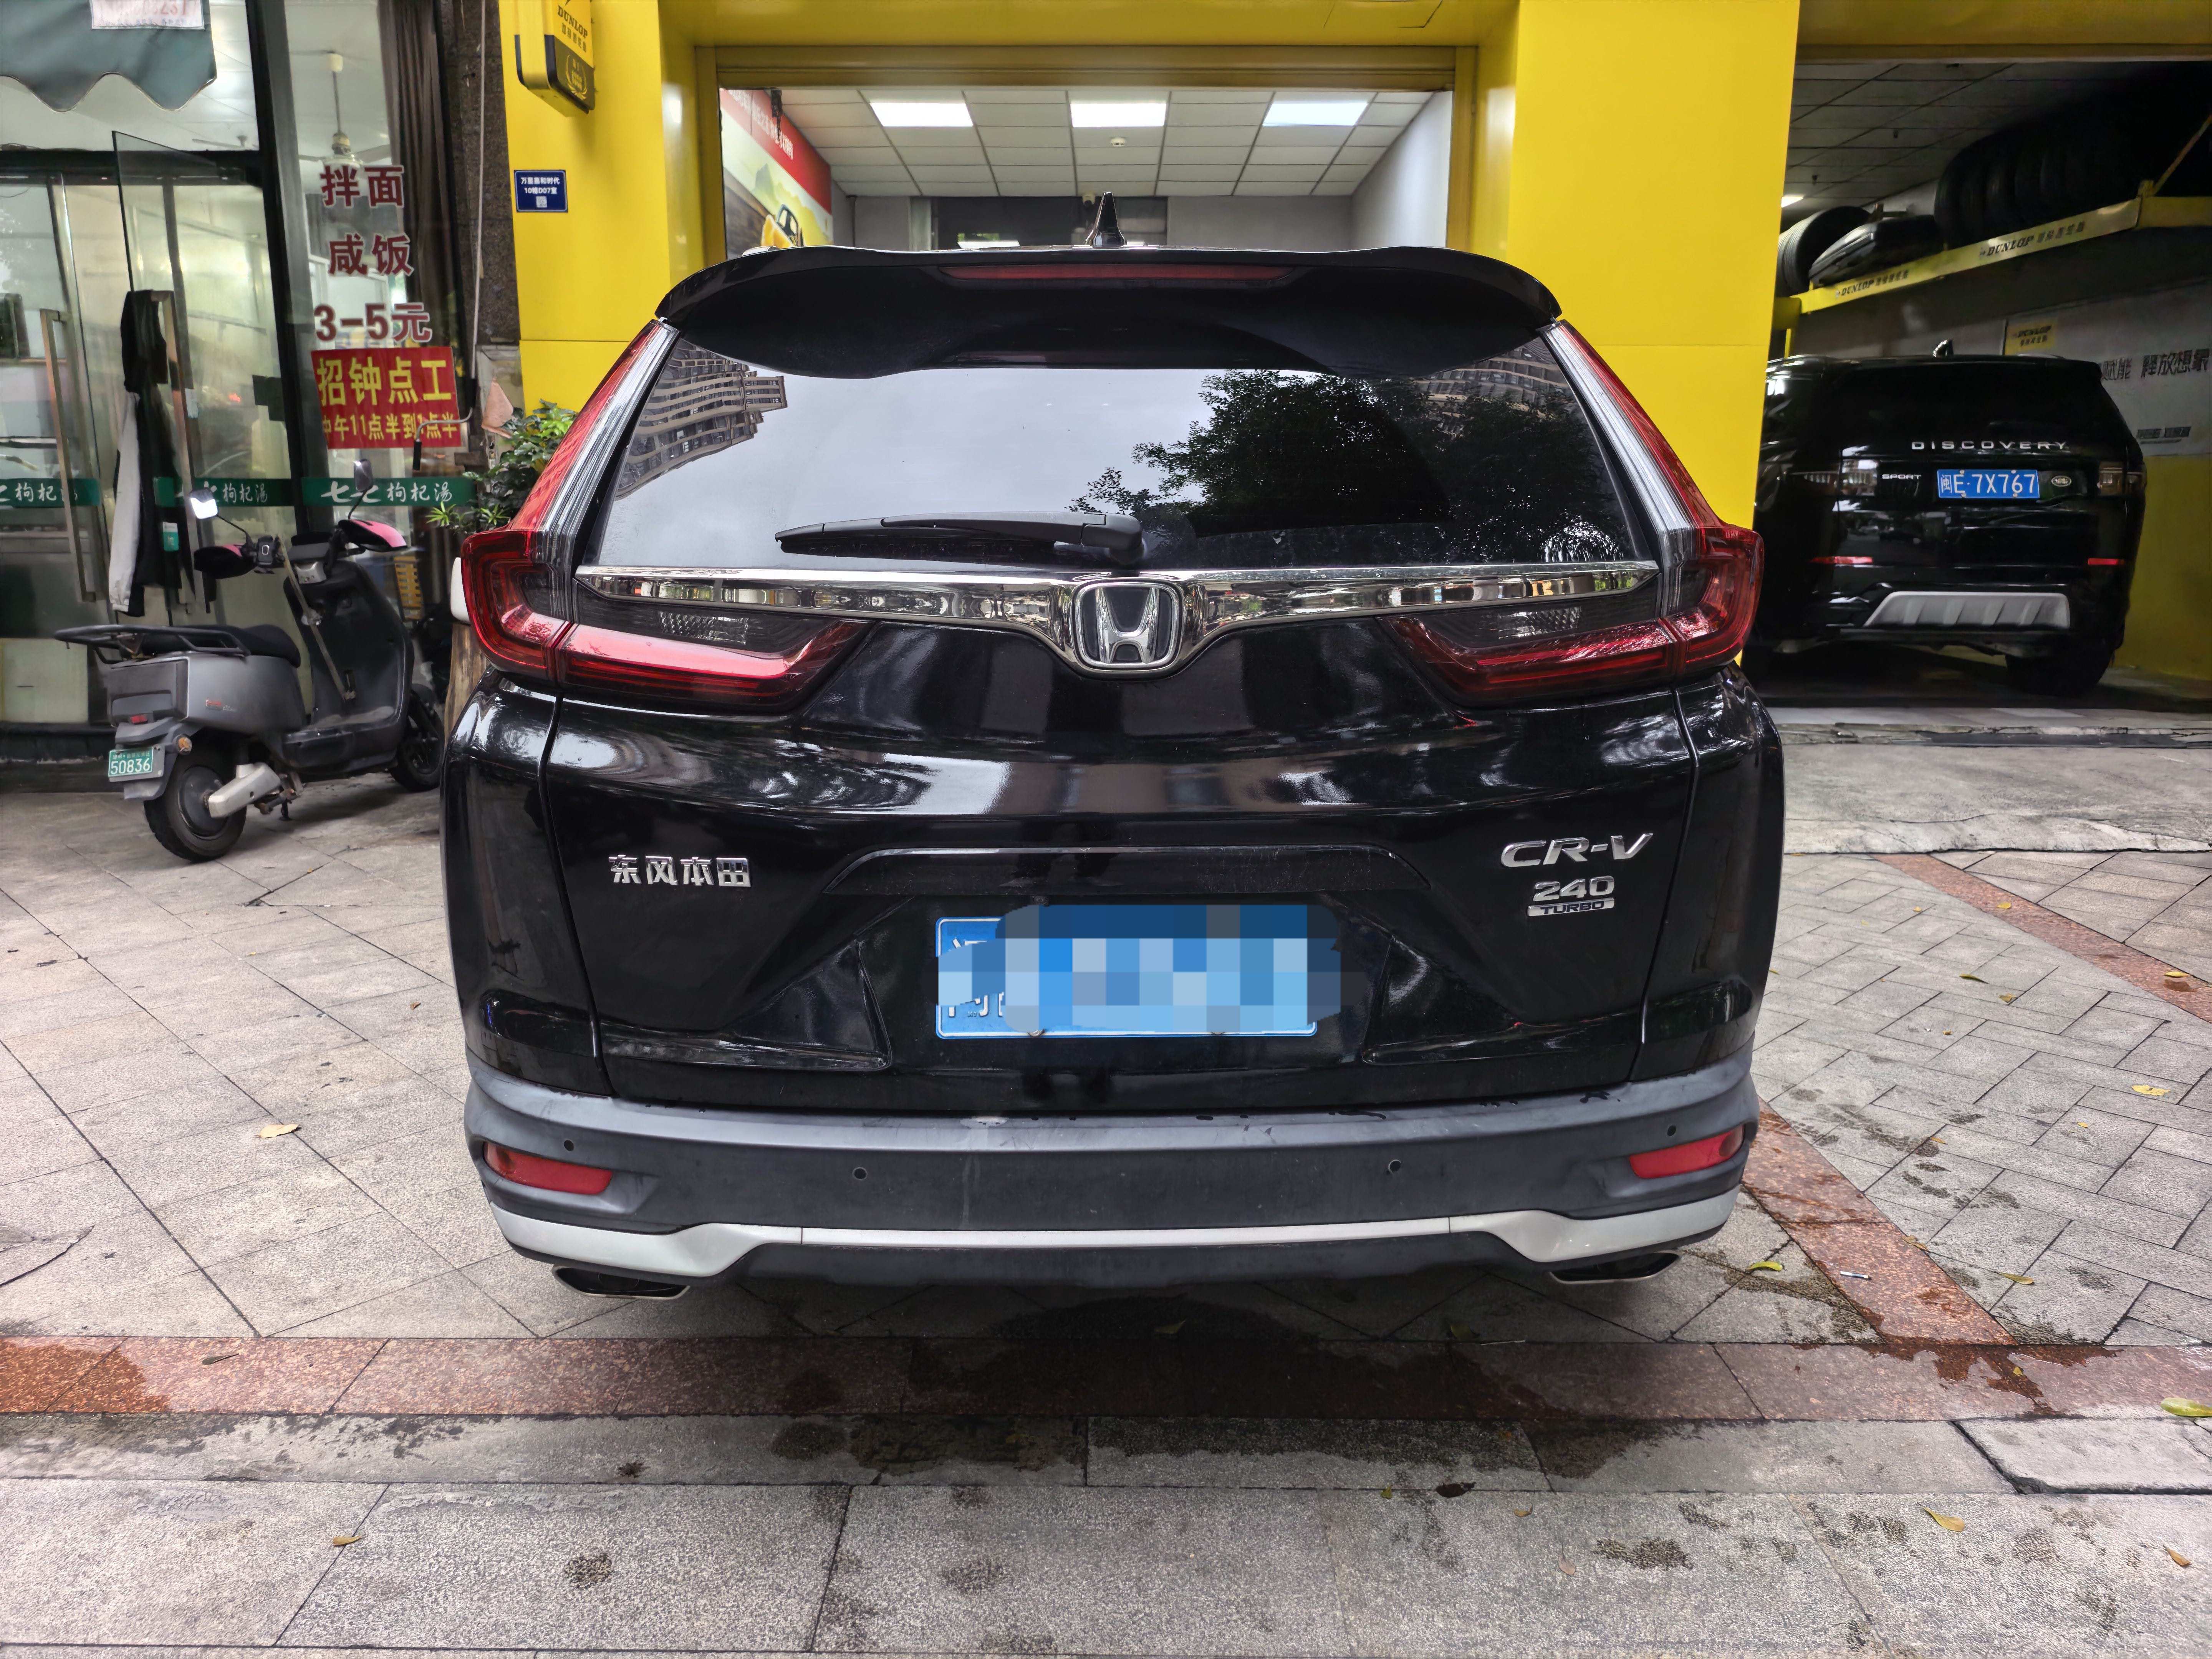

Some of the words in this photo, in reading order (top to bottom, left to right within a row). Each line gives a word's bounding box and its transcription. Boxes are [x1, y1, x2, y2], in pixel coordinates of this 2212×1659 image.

[558, 5, 588, 38] DUNLOP
[320, 165, 404, 208] 拌面
[328, 233, 414, 276] 咸饭
[1986, 235, 2034, 256] DUNLOP
[313, 302, 432, 342] 3-5元
[317, 356, 451, 406] 招钟点工
[322, 411, 457, 442] 中午11点半到1点半
[1912, 441, 2066, 450] DISCOVERY
[111, 758, 150, 774] 50836
[1501, 833, 1653, 867] CR-V
[609, 854, 751, 887] 东风本田
[1533, 876, 1614, 901] 240
[1540, 901, 1604, 915] TURBO
